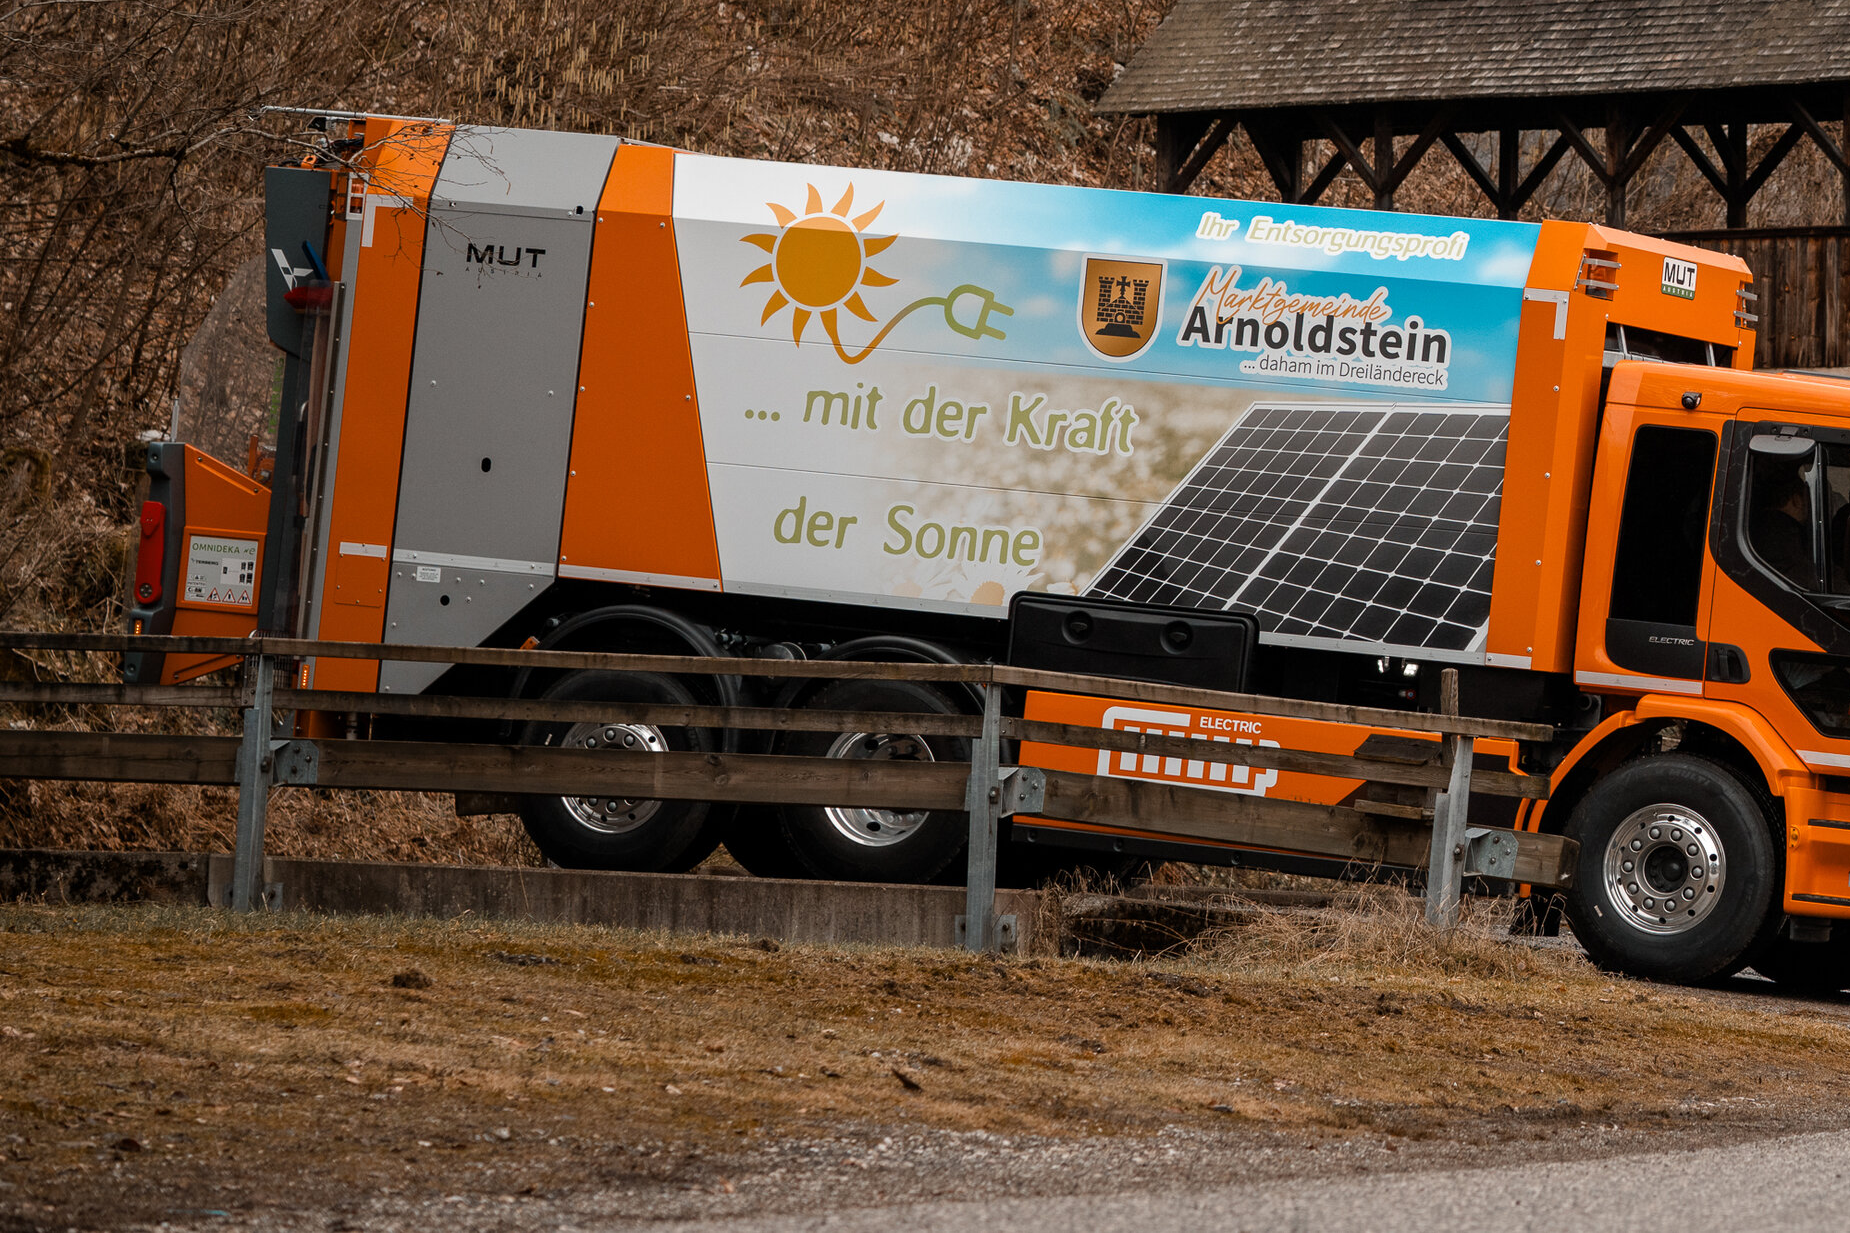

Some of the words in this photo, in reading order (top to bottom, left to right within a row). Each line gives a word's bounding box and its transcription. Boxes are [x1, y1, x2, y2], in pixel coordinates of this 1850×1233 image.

[1199, 215, 1236, 238] Ihr
[1248, 218, 1468, 257] Entsorgungsprofi
[466, 243, 546, 268] MUT
[1664, 262, 1695, 287] MUT
[1194, 269, 1388, 325] Marktgemeinde
[1663, 285, 1693, 298] AUSTRIA
[1181, 305, 1447, 364] Arnoldstein
[1259, 355, 1312, 375] daham
[1316, 362, 1335, 376] im
[1339, 362, 1444, 386] Dreiländereck
[803, 382, 884, 430] mit
[903, 386, 987, 439] der
[1007, 395, 1136, 453] Kraft
[773, 495, 858, 549] der
[883, 505, 1040, 567] Sonne
[192, 542, 240, 554] OMNIDEKA
[1649, 636, 1695, 646] ELECTRIC
[1200, 716, 1262, 735] ELECTRIC
